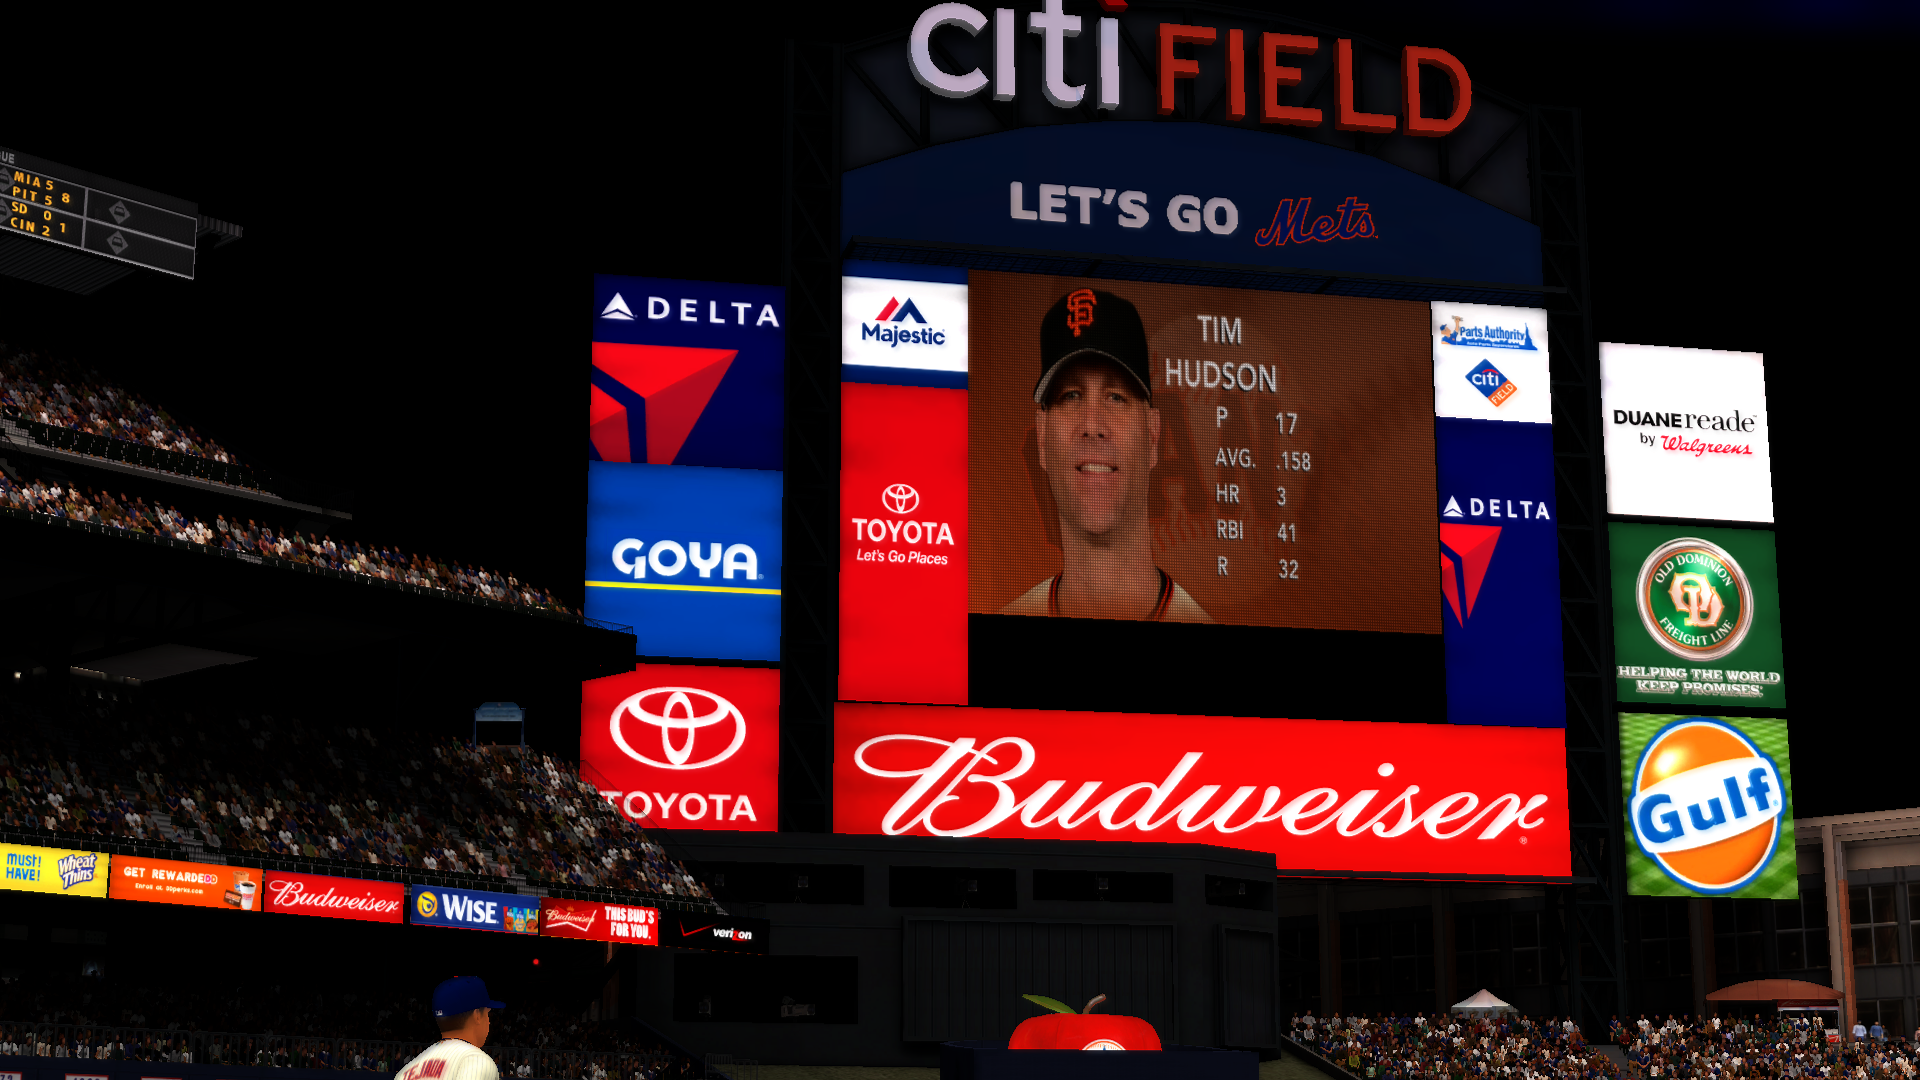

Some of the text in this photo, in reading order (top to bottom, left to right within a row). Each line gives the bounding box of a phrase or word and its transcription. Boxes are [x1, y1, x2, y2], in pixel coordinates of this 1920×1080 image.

[907, 0, 1472, 138] citi FIELD
[14, 171, 54, 190] MIA 5
[13, 186, 52, 205] PIT 5
[62, 192, 70, 203] 8
[12, 201, 52, 221] SD 0
[1010, 181, 1376, 246] LET'S GO Mets
[11, 217, 50, 236] CIN 2
[60, 222, 66, 233] 1
[647, 296, 780, 327] DELTA
[861, 322, 945, 347] Majestic
[1197, 315, 1241, 344] TIM
[1460, 325, 1524, 341] Parts Authority
[1166, 358, 1276, 392] HUDSON
[1471, 371, 1499, 387] citi
[1490, 383, 1514, 405] FIELD
[1216, 406, 1298, 434] P 17
[1640, 432, 1753, 457] by Walgreens
[1215, 448, 1311, 471] AVG. .158
[1216, 484, 1286, 506] HR 3
[1470, 497, 1551, 520] DELTA
[852, 518, 955, 546] TOYOTA
[1216, 519, 1296, 542] RBI 41
[612, 538, 758, 580] GOYA
[857, 548, 948, 565] Let's Go Places
[1217, 556, 1299, 579] R 32
[1654, 553, 1734, 587] OLD DOMINION
[1659, 617, 1734, 646] FREIGHT LINE
[1617, 666, 1781, 685] HELPING THE WORLD
[1636, 680, 1679, 694] KEEP
[854, 734, 1548, 838] Budweiser
[1637, 767, 1771, 844] Gulf
[6, 867, 41, 881] HAVE!
[58, 853, 97, 876] Wheat
[124, 866, 146, 878] GET
[62, 868, 93, 890] Thins
[269, 879, 399, 914] Budweiser
[442, 893, 497, 924] WISE
[546, 909, 595, 923] Budweiser
[604, 905, 655, 924] THIS BUD'S
[610, 922, 651, 940] FOR YOU.
[713, 927, 752, 942] verizon
